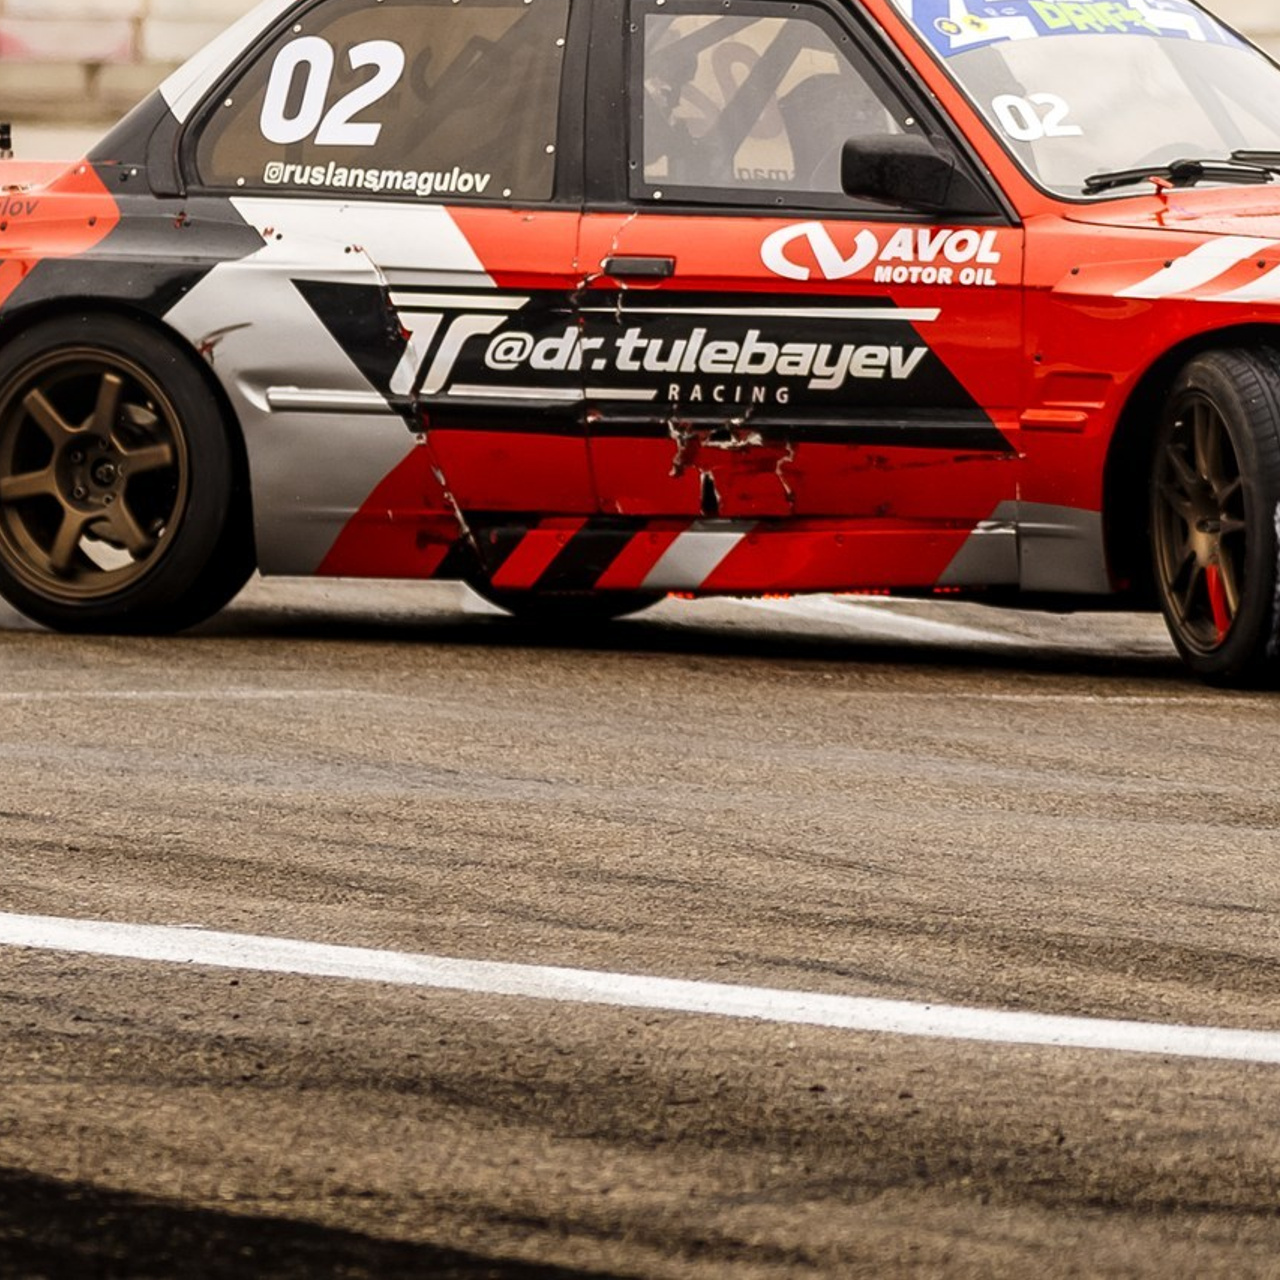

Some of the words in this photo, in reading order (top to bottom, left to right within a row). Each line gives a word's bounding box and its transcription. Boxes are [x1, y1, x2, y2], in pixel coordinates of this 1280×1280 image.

[260, 35, 405, 146] 02
[991, 92, 1084, 142] 02
[878, 227, 1001, 264] AVOL
[874, 266, 954, 285] MOTOR
[959, 268, 998, 286] OIL
[484, 325, 929, 390] @dr.tulebayev
[667, 383, 790, 404] RACING
